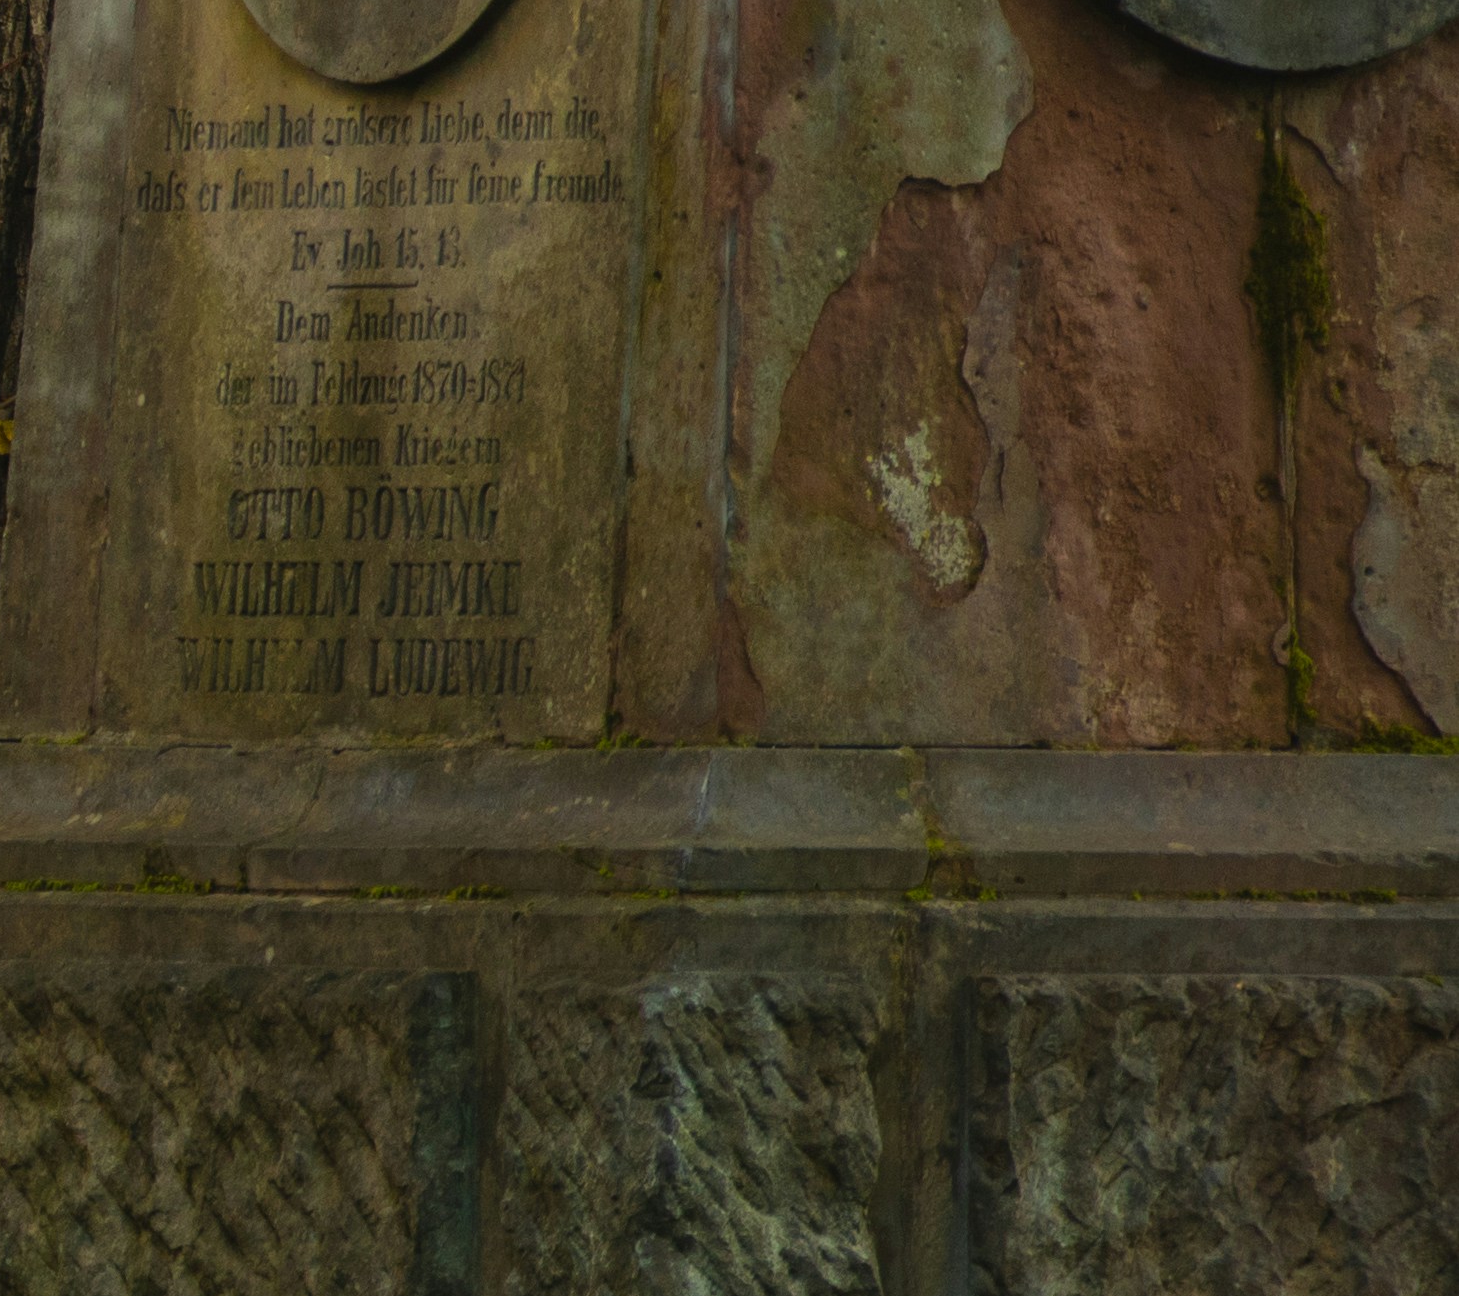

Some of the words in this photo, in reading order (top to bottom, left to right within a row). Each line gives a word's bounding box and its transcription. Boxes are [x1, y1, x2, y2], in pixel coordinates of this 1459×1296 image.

[164, 105, 270, 152] Niemand
[276, 104, 315, 149] hat
[496, 98, 554, 142] denn
[198, 181, 223, 214] er
[424, 163, 459, 206] für
[275, 299, 331, 344] Dem
[215, 362, 255, 407] der
[269, 365, 299, 406] im
[310, 358, 408, 414] Feldzuge
[394, 422, 503, 469] Kriegern
[226, 486, 325, 542] OTTO
[344, 475, 500, 543] BÖWING
[192, 561, 365, 618] WILHELM
[367, 636, 535, 697] LUDEWIG
